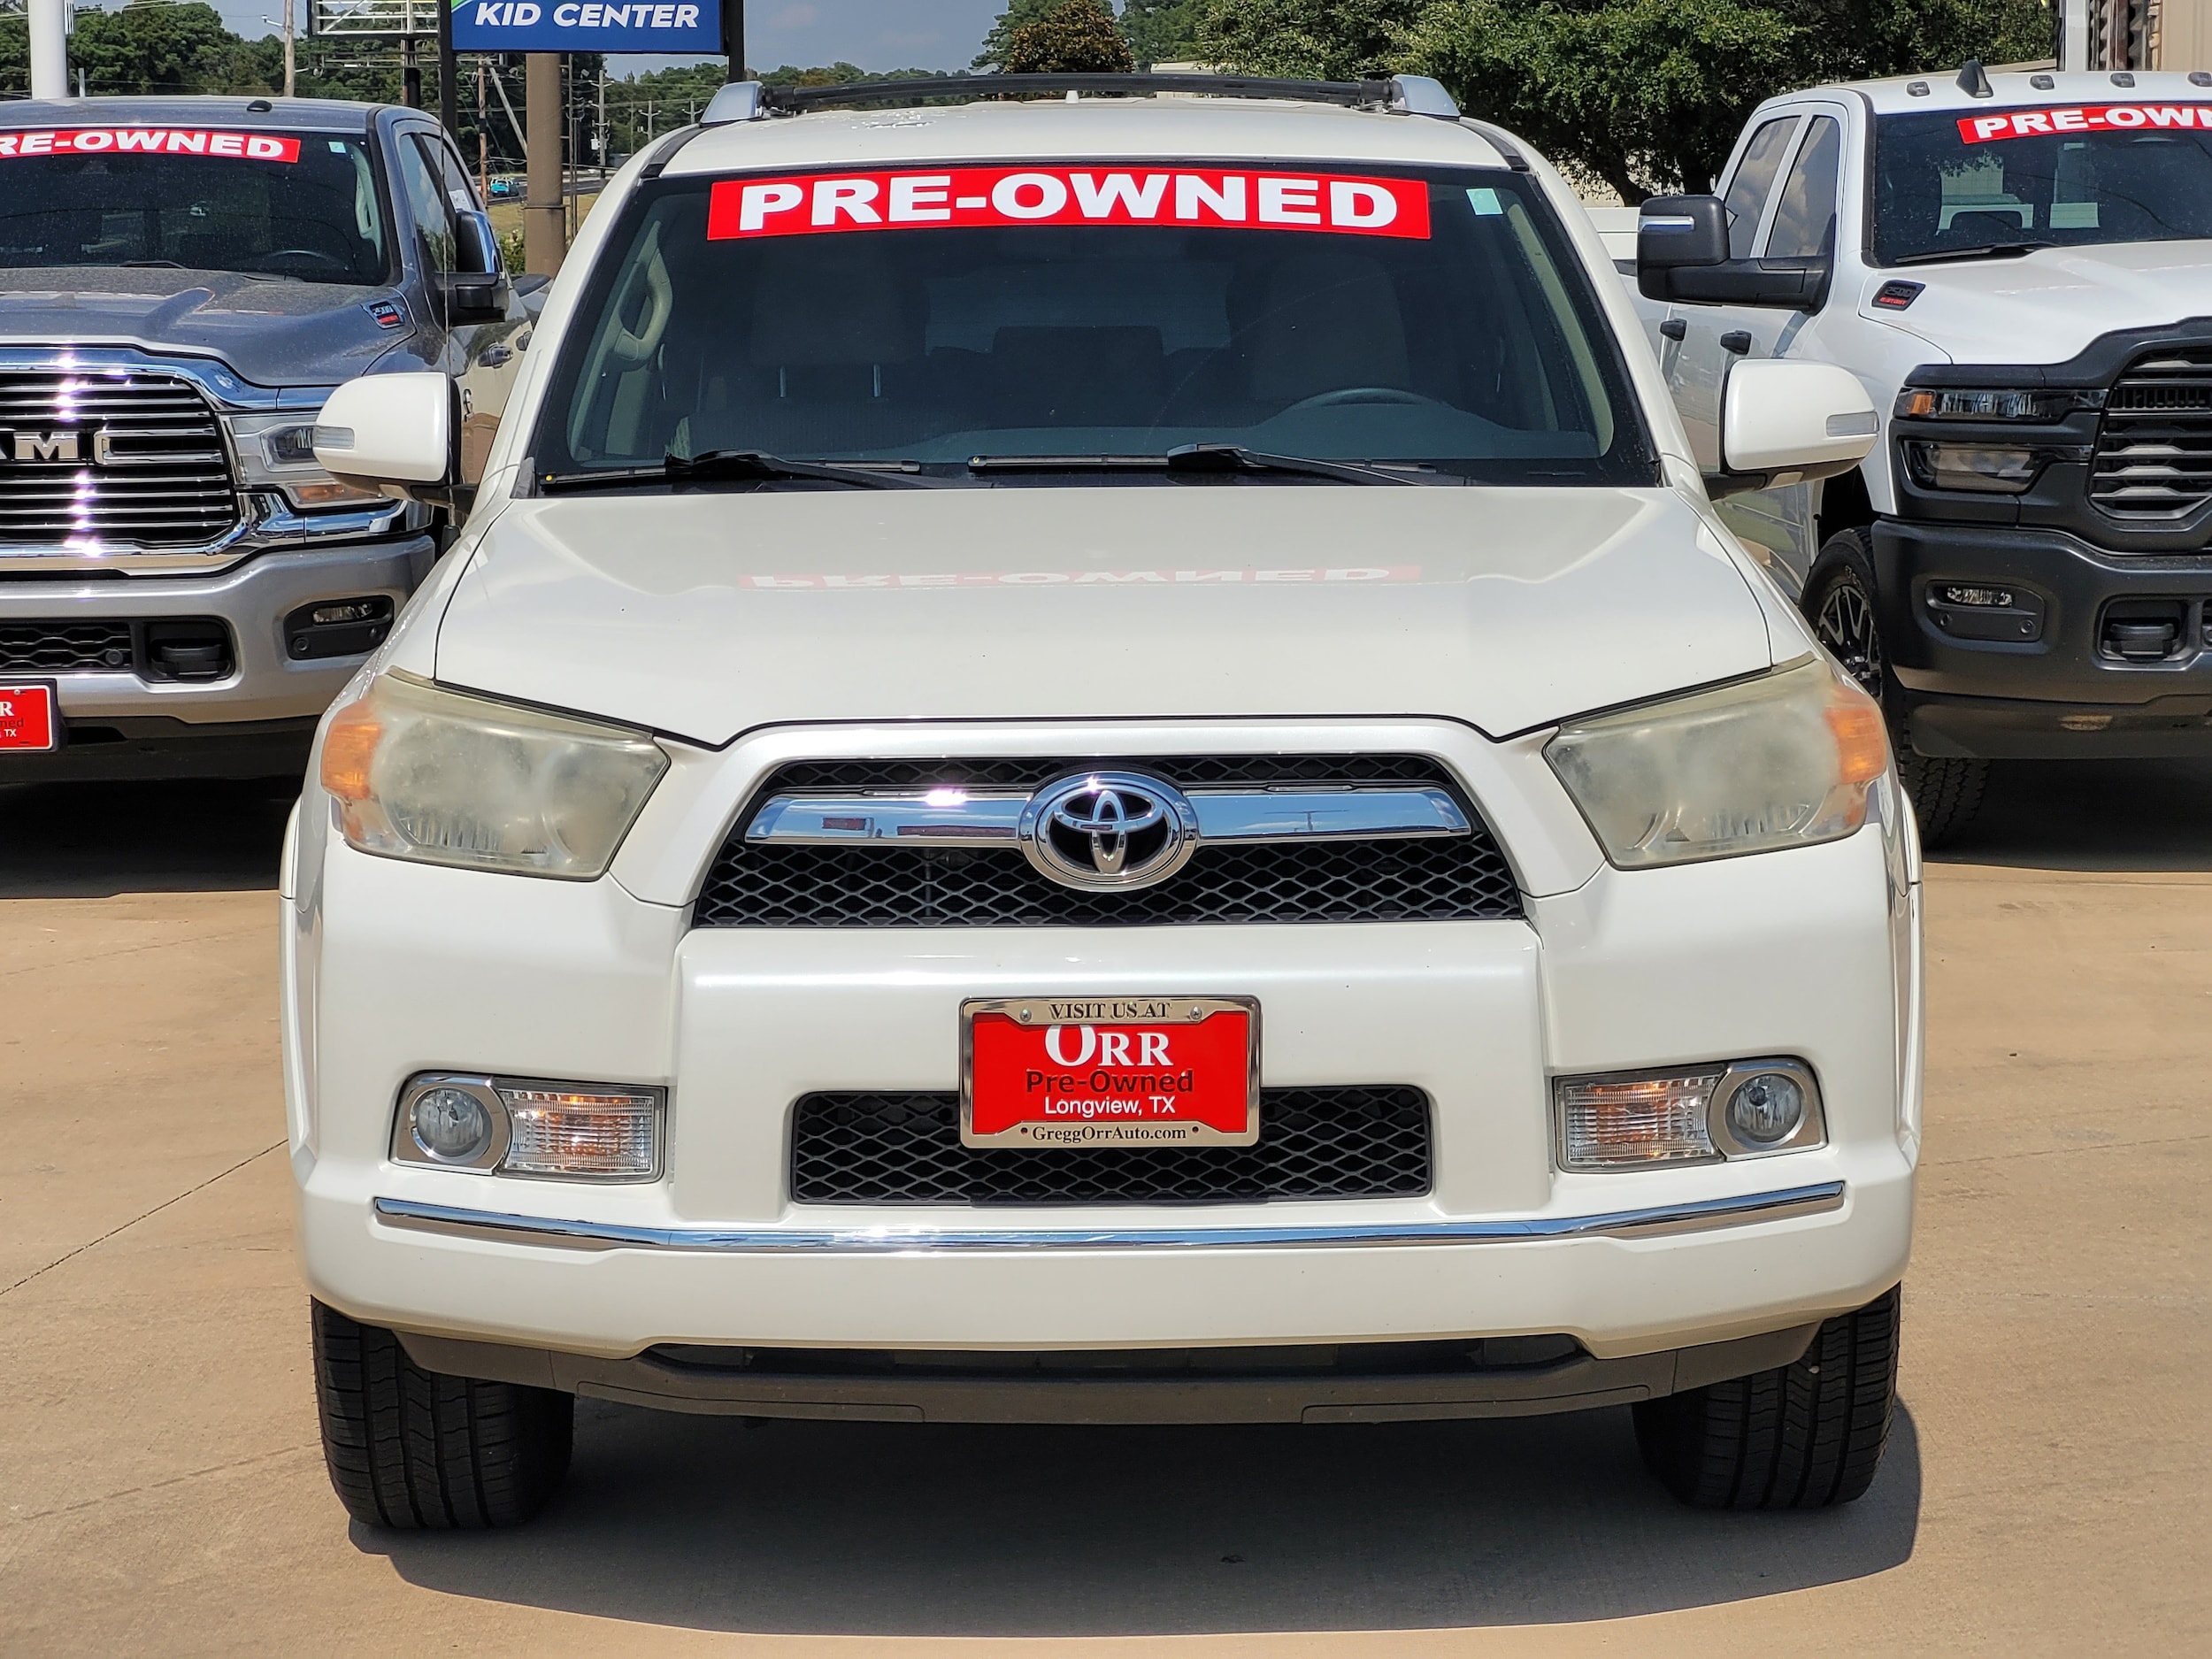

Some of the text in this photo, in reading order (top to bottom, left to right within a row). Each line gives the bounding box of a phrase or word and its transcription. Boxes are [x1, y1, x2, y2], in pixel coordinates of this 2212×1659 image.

[474, 3, 700, 28] KID CENTER
[739, 173, 1398, 230] PRE-OWNED
[1049, 1002, 1171, 1019] VISIT US AT
[1044, 1025, 1174, 1067] ORR
[1025, 1069, 1194, 1094] Pre-Owned
[1044, 1096, 1176, 1118] Longview, TX
[1032, 1125, 1187, 1144] GreggOrrAuto.com
